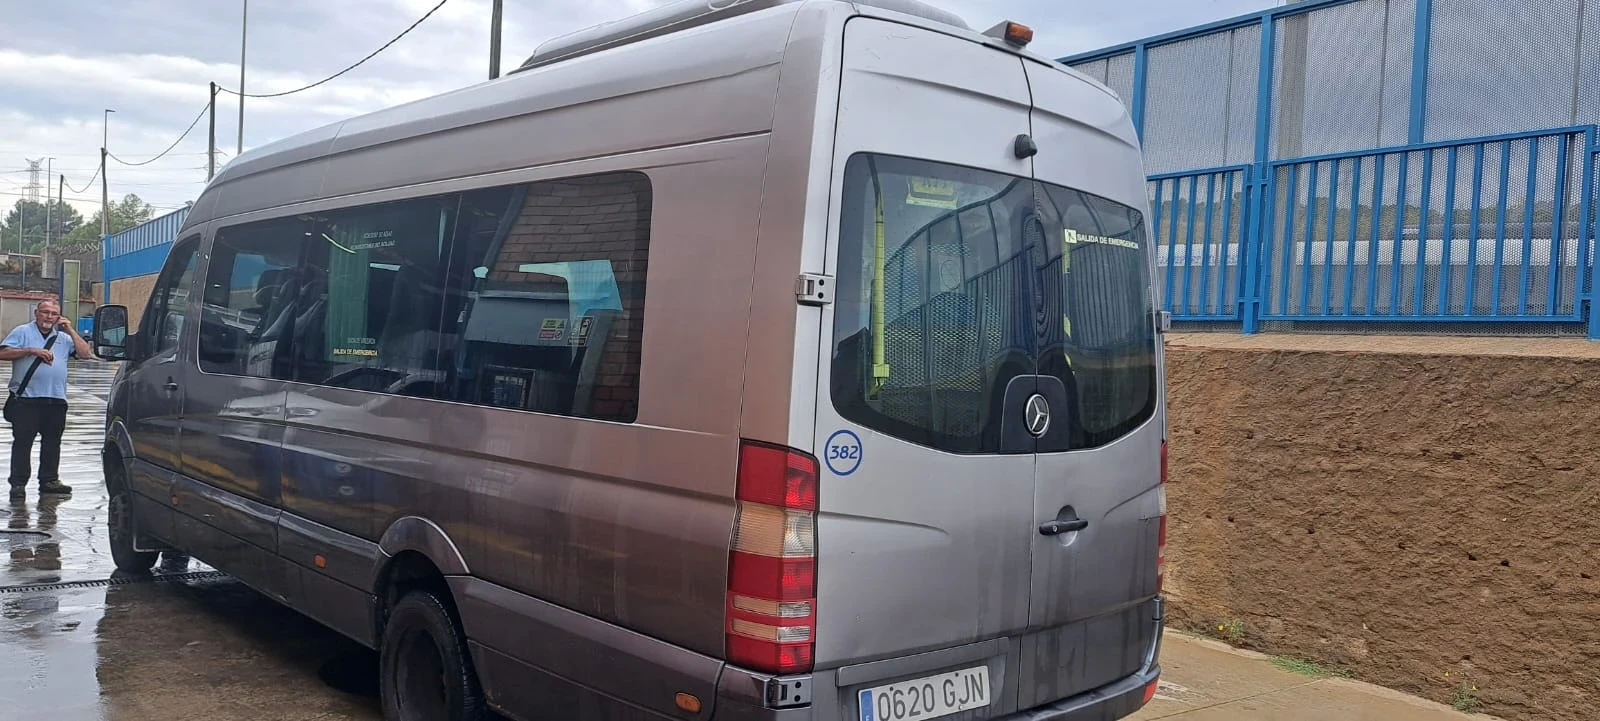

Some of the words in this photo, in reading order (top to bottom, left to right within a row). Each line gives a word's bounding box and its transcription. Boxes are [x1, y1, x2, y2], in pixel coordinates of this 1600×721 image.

[1077, 234, 1098, 243] SALIDA
[1100, 236, 1108, 244] DE
[830, 445, 859, 460] 382
[877, 683, 935, 721] 0620
[943, 673, 984, 707] GJN
